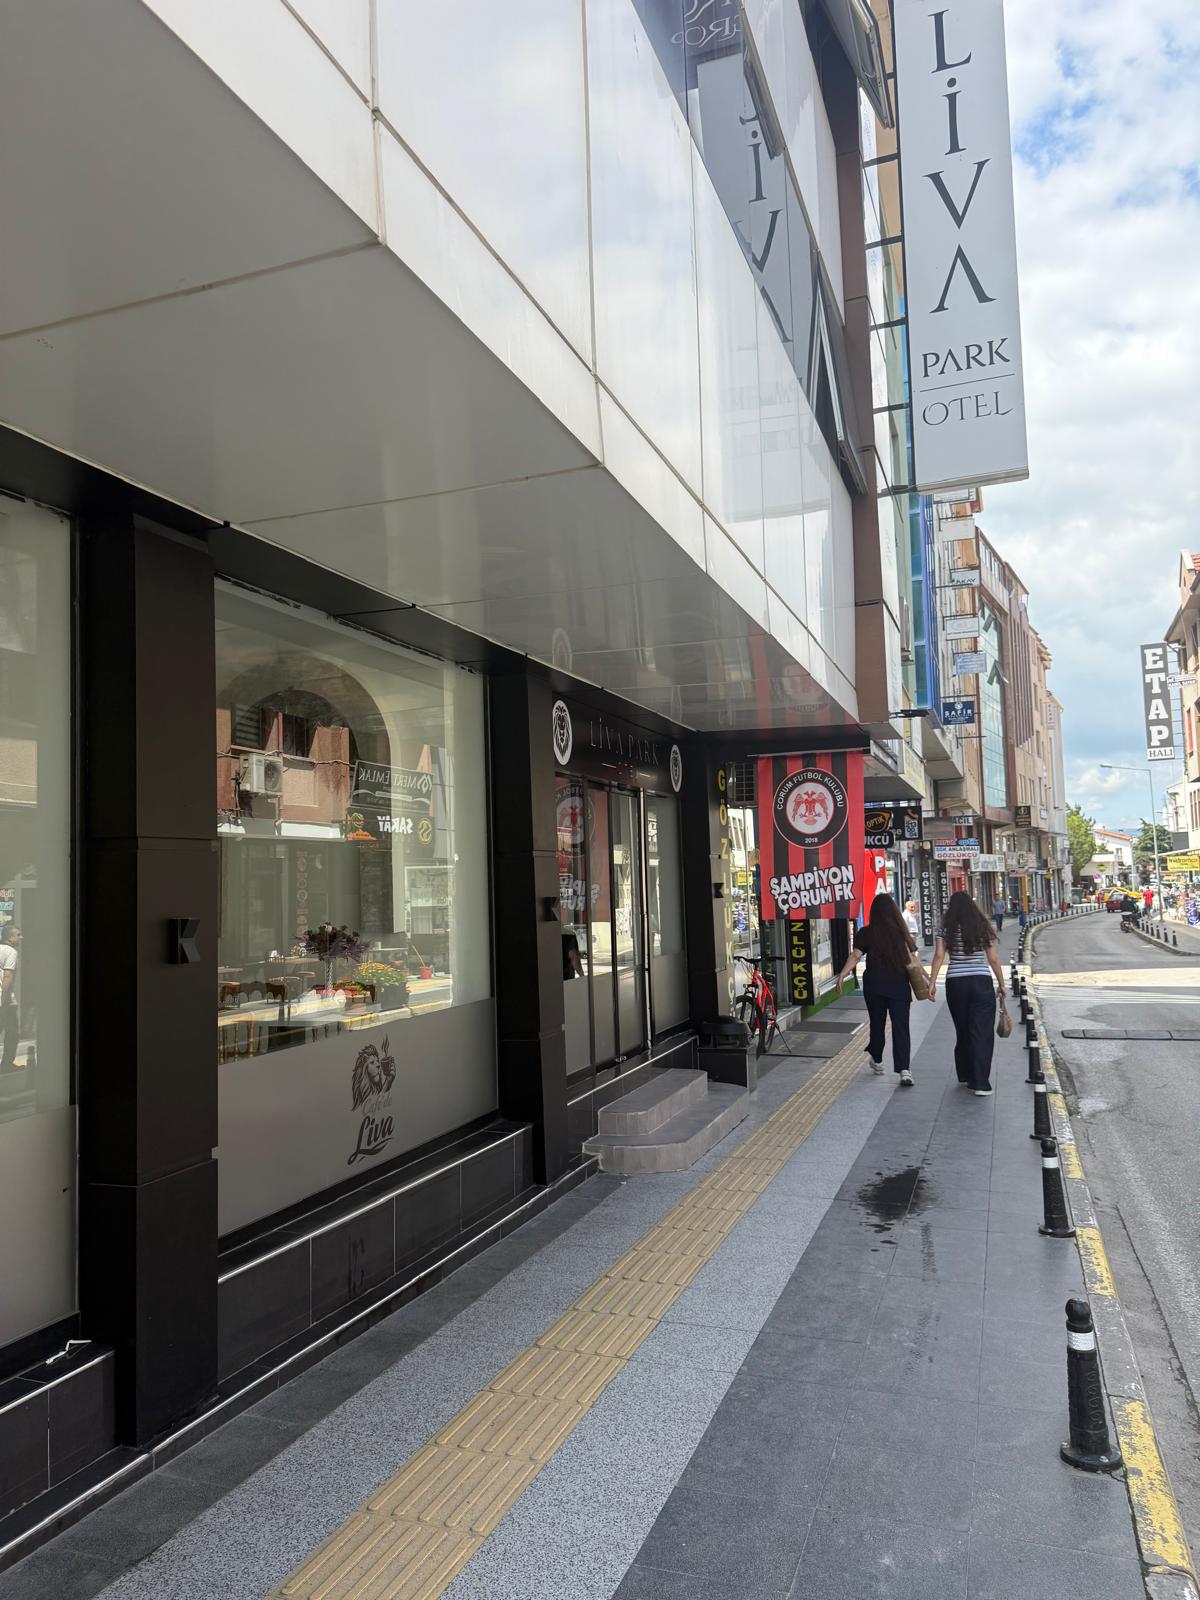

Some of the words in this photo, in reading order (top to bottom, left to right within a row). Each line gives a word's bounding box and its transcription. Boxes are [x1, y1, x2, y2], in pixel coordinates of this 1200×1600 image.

[921, 337, 1011, 379] PARK
[922, 390, 1015, 427] OTEL
[1143, 647, 1169, 747] ETAP
[628, 734, 660, 767] PARK
[1148, 748, 1174, 759] HALI
[793, 771, 823, 784] FUTBOL
[769, 864, 855, 900] ŞAMPİYON
[777, 885, 833, 915] ÇORUM
[834, 883, 855, 901] FK
[790, 921, 809, 1000] ZLÜKÇÜ
[347, 1115, 394, 1166] Liva
